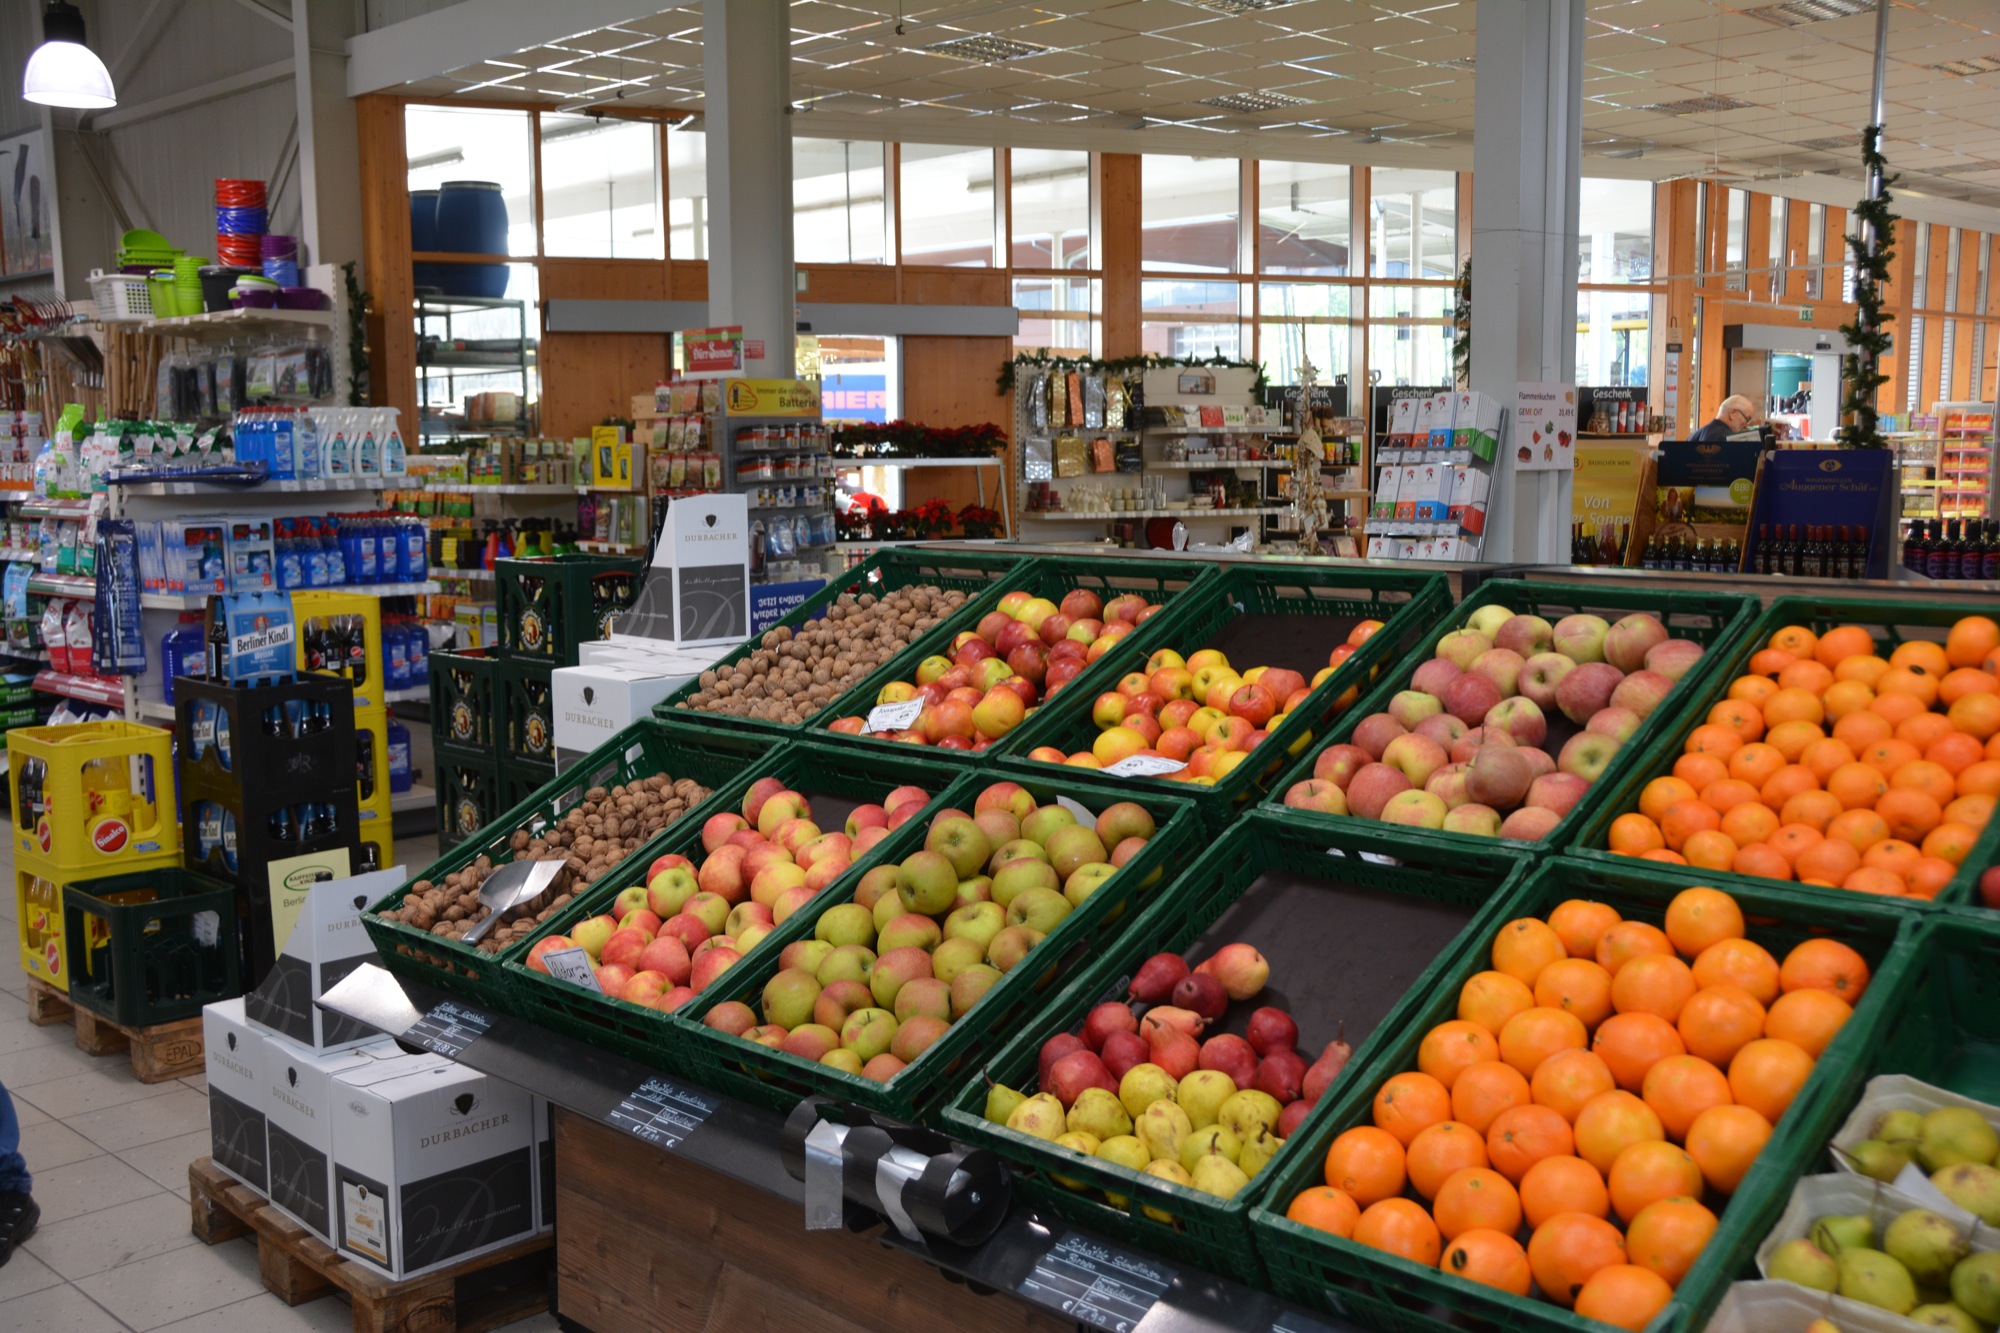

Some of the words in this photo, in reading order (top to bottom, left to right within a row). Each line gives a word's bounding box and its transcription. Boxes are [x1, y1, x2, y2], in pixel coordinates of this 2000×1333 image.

[1391, 388, 1435, 399] Geschenk
[1518, 391, 1556, 401] Flammenkuchen
[1592, 388, 1632, 399] Geschenk
[779, 398, 817, 409] Batterie
[1584, 495, 1611, 510] Von
[1590, 512, 1632, 526] Sonne
[684, 533, 738, 542] DURBACHER
[758, 597, 777, 607] JETZT
[779, 594, 804, 605] ENDLICH
[753, 609, 778, 620] WIEDER
[237, 635, 267, 653] Berliner
[268, 627, 289, 644] Kindl
[564, 711, 615, 730] DURBACHER
[97, 825, 125, 848] Sinalco
[327, 917, 365, 932] DURBA
[165, 1044, 195, 1062] EPAL
[213, 1051, 254, 1081] DURBACHER
[272, 1086, 315, 1119] DURBACHER
[420, 1113, 510, 1149] DURBACHER
